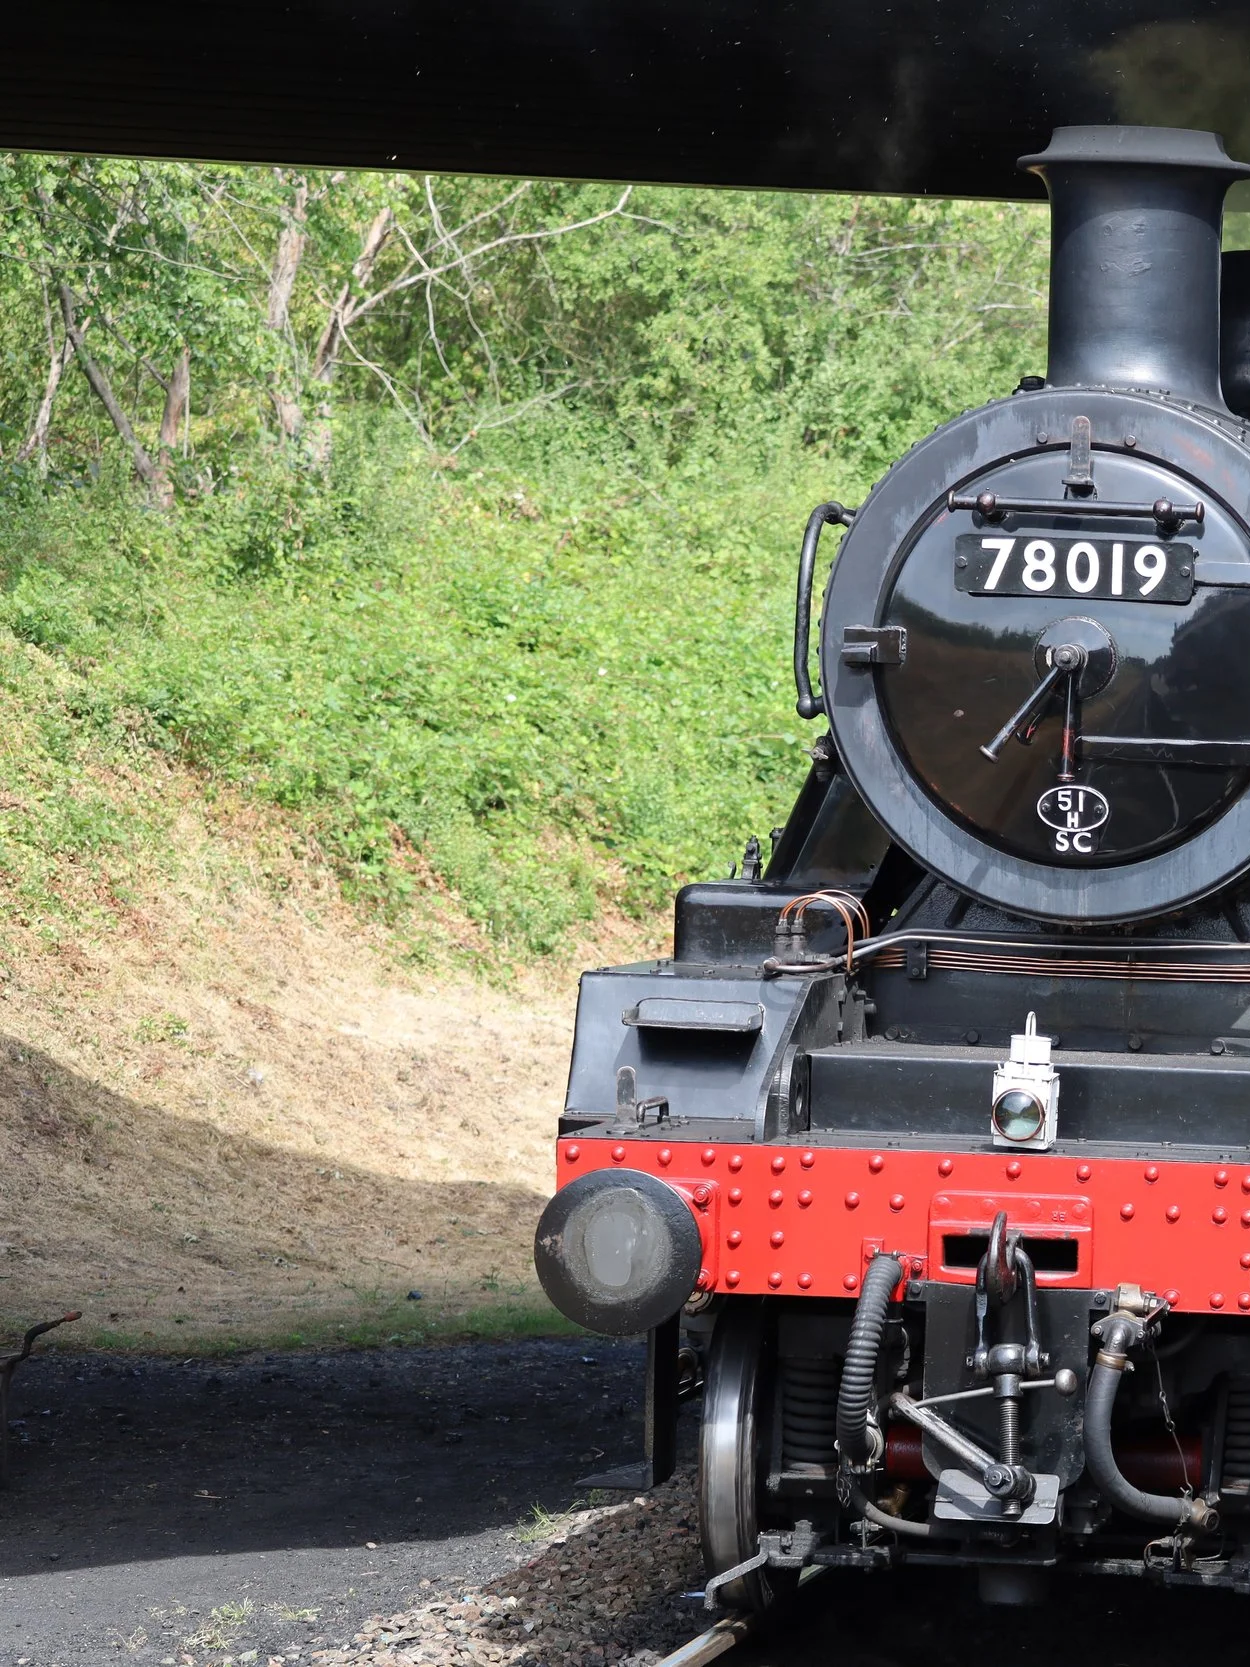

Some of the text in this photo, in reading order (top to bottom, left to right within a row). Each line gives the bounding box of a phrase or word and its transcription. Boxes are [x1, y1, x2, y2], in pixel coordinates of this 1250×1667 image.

[981, 538, 1167, 596] 78019
[1057, 790, 1084, 812] 51
[1066, 811, 1079, 828] H
[1055, 831, 1092, 853] SC
